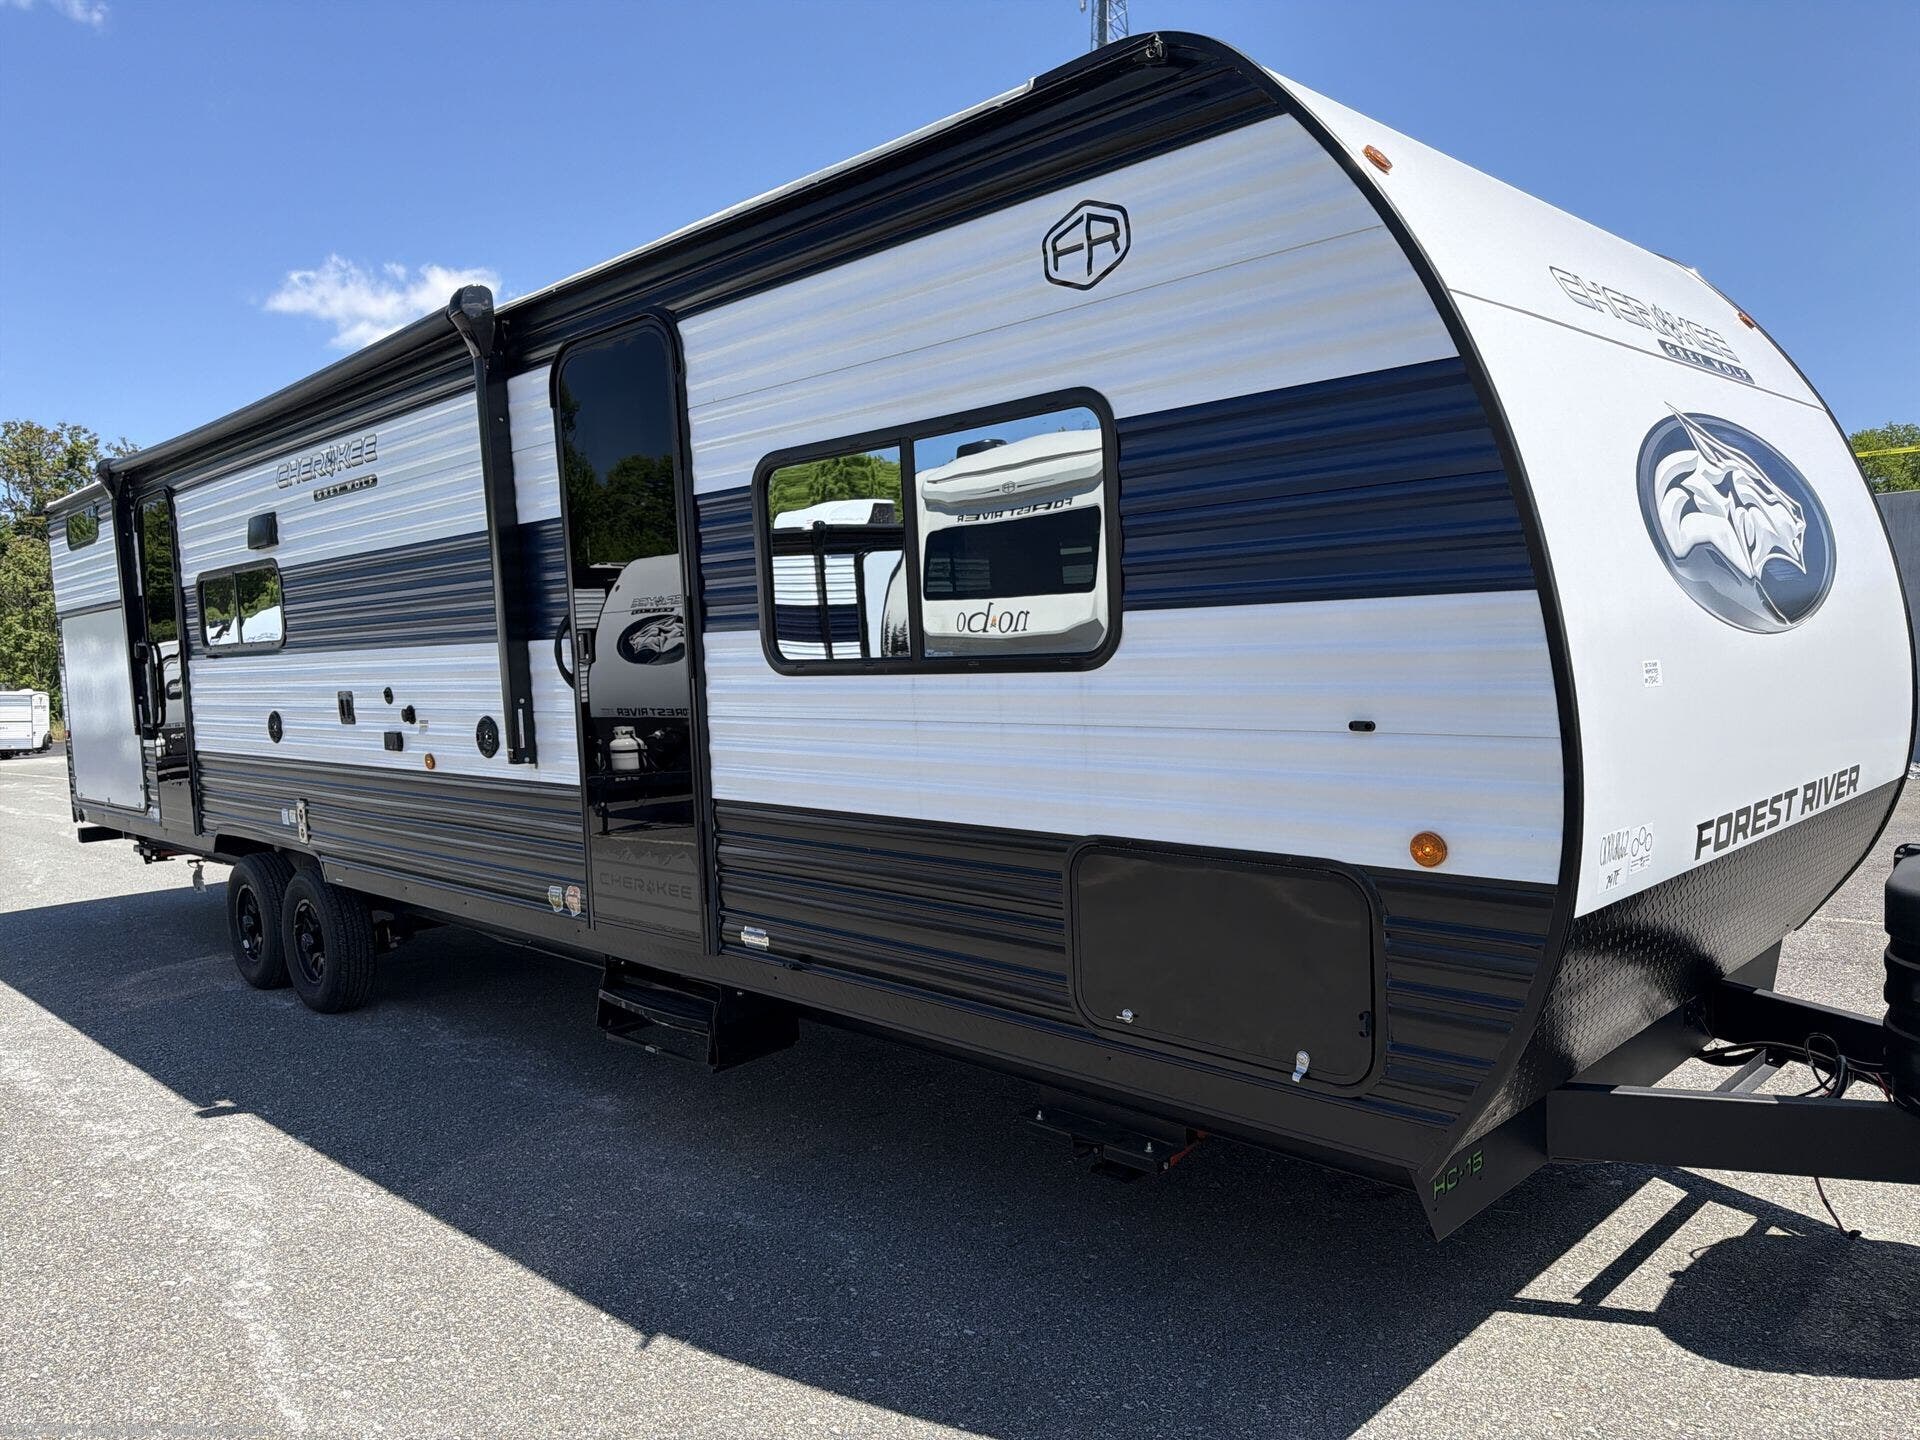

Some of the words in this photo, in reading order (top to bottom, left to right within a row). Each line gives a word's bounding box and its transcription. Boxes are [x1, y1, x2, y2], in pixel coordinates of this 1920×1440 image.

[1548, 265, 1741, 364] CHEROKEE
[1664, 343, 1708, 366] GREY
[1710, 357, 1751, 380] WOLF
[276, 434, 377, 489] CHEROKEE
[316, 486, 341, 499] GREY
[345, 476, 375, 491] WOLF
[1694, 787, 1798, 861] FOREST
[1800, 764, 1860, 816] RIVER
[600, 872, 692, 900] CHEROKEE
